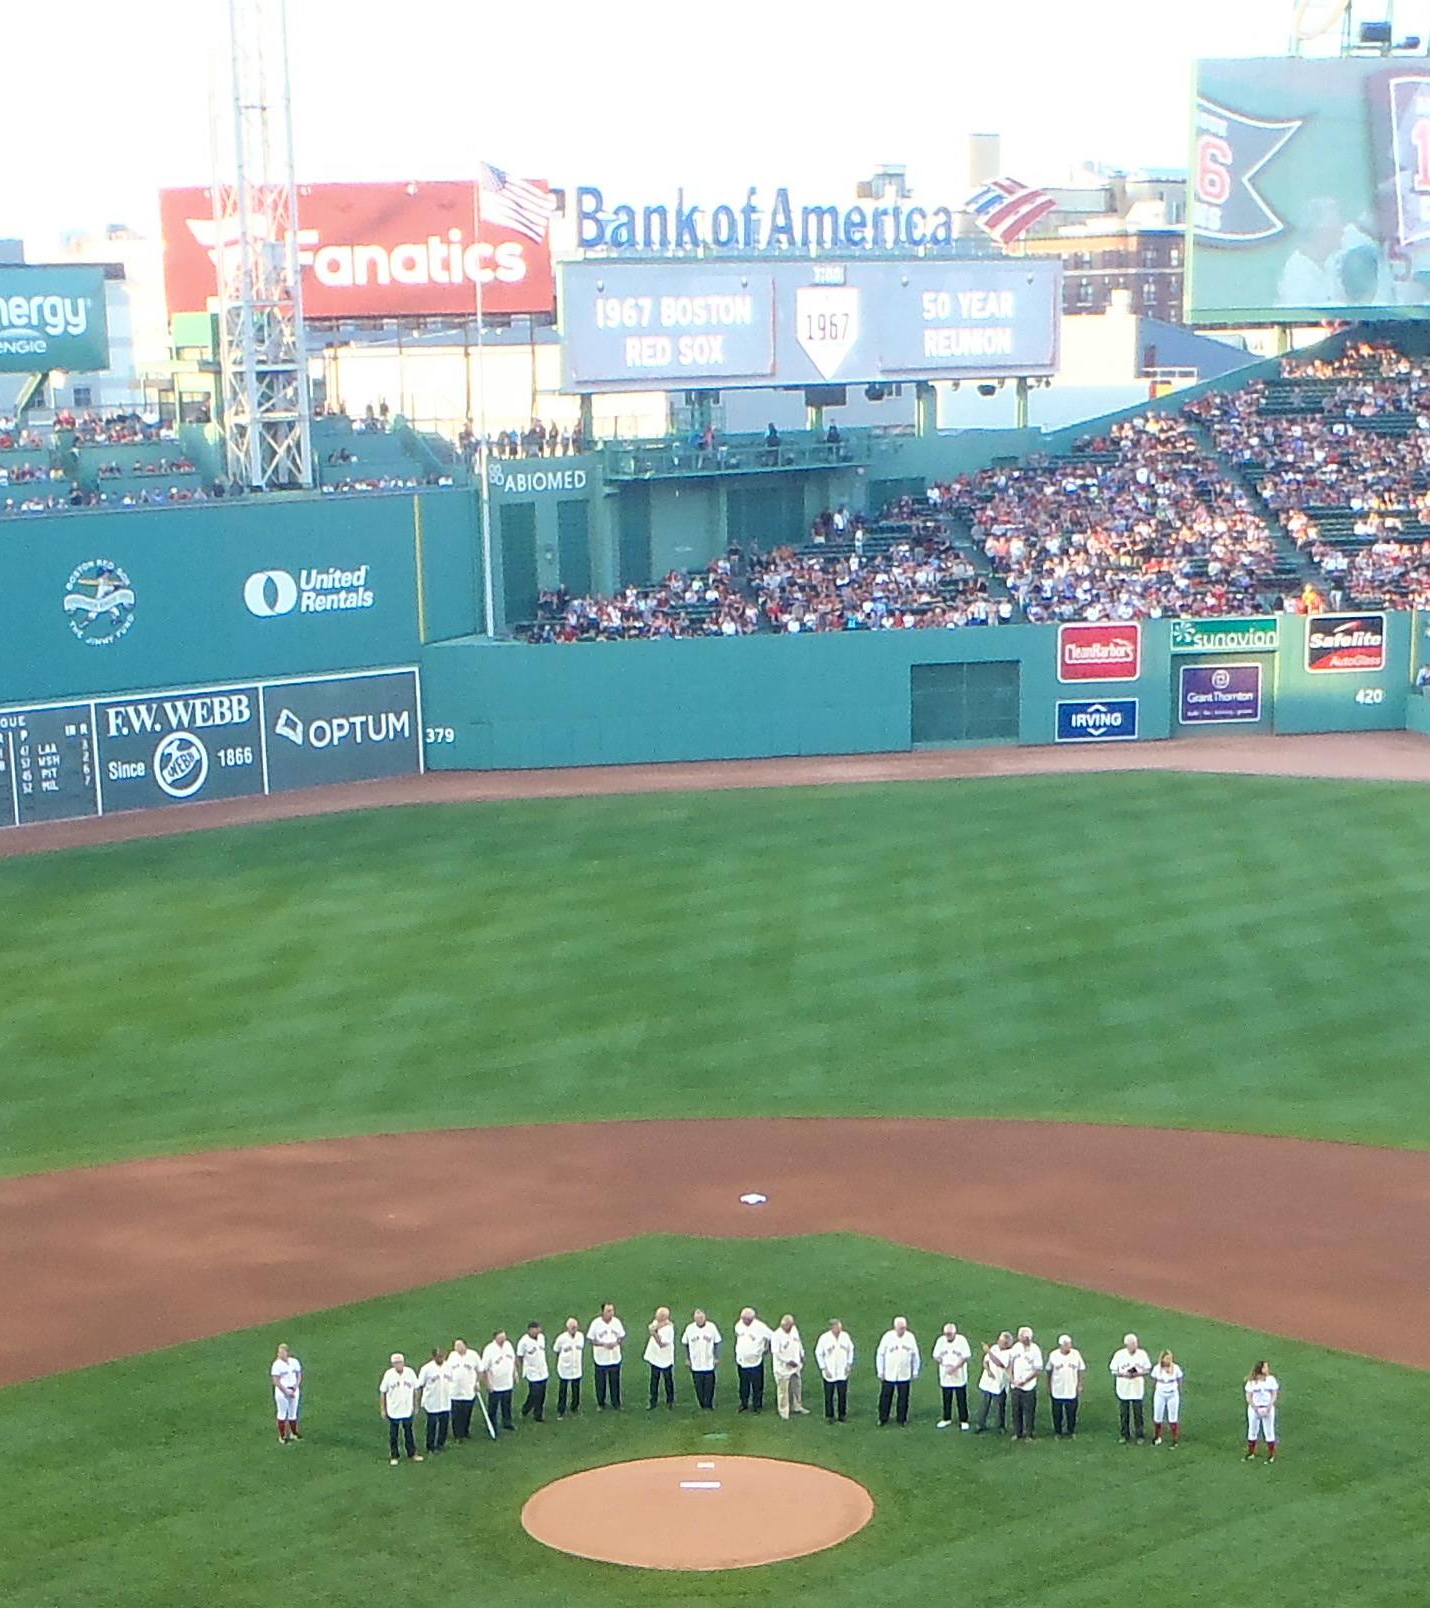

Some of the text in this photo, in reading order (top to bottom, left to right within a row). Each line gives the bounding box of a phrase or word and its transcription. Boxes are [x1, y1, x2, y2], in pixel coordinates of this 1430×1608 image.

[577, 187, 954, 249] Bank of America
[285, 228, 527, 287] Fanatics
[596, 295, 752, 328] 1967 BOSTON
[922, 290, 1014, 320] 50 YEAR
[807, 313, 851, 341] 1967
[626, 334, 725, 366] RED SOX
[924, 327, 1012, 358] REUNION
[504, 471, 586, 492] ABIOMED
[299, 566, 368, 592] United
[301, 587, 373, 613] Rentals
[1193, 627, 1277, 649] sunovion
[1309, 631, 1383, 650] Safelite
[1328, 655, 1383, 668] AutoGlass
[1187, 691, 1254, 704] Grant Thornton
[1355, 688, 1383, 704] 420
[106, 694, 251, 737] F.W. WEBB
[1071, 712, 1122, 728] IRVING
[308, 711, 410, 749] OPTUM
[426, 728, 455, 744] 379
[38, 743, 58, 755] LAA
[218, 747, 253, 768] 1866
[108, 760, 146, 780] Since
[167, 752, 194, 777] WEBB
